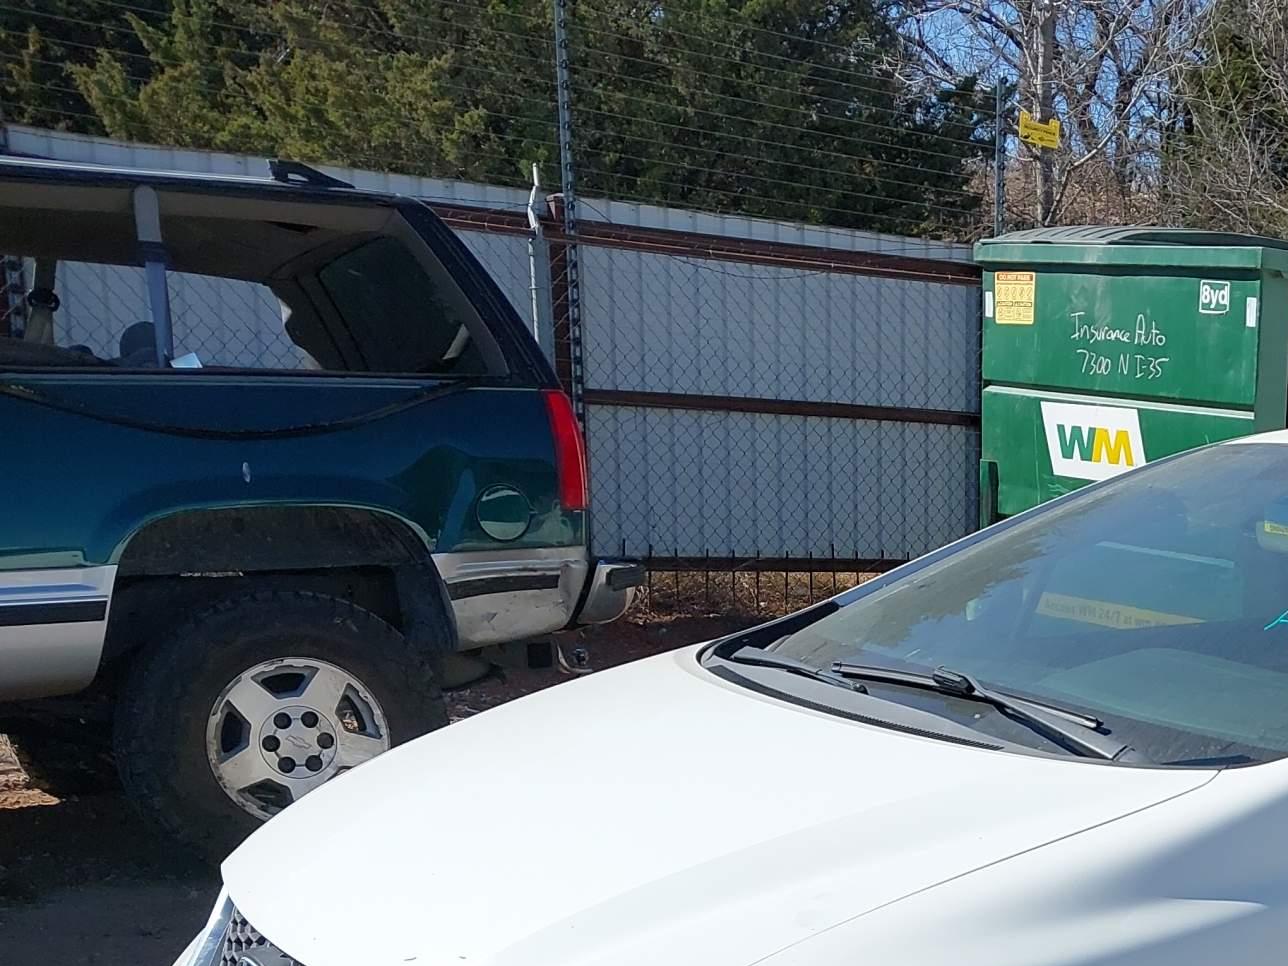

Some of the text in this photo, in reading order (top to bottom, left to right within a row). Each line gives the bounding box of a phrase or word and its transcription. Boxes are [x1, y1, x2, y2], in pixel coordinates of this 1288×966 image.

[1202, 285, 1228, 308] 8yd
[1071, 312, 1166, 346] Insurance Auto
[1076, 350, 1111, 375] 7300
[1118, 353, 1130, 375] N
[1057, 424, 1135, 467] WM
